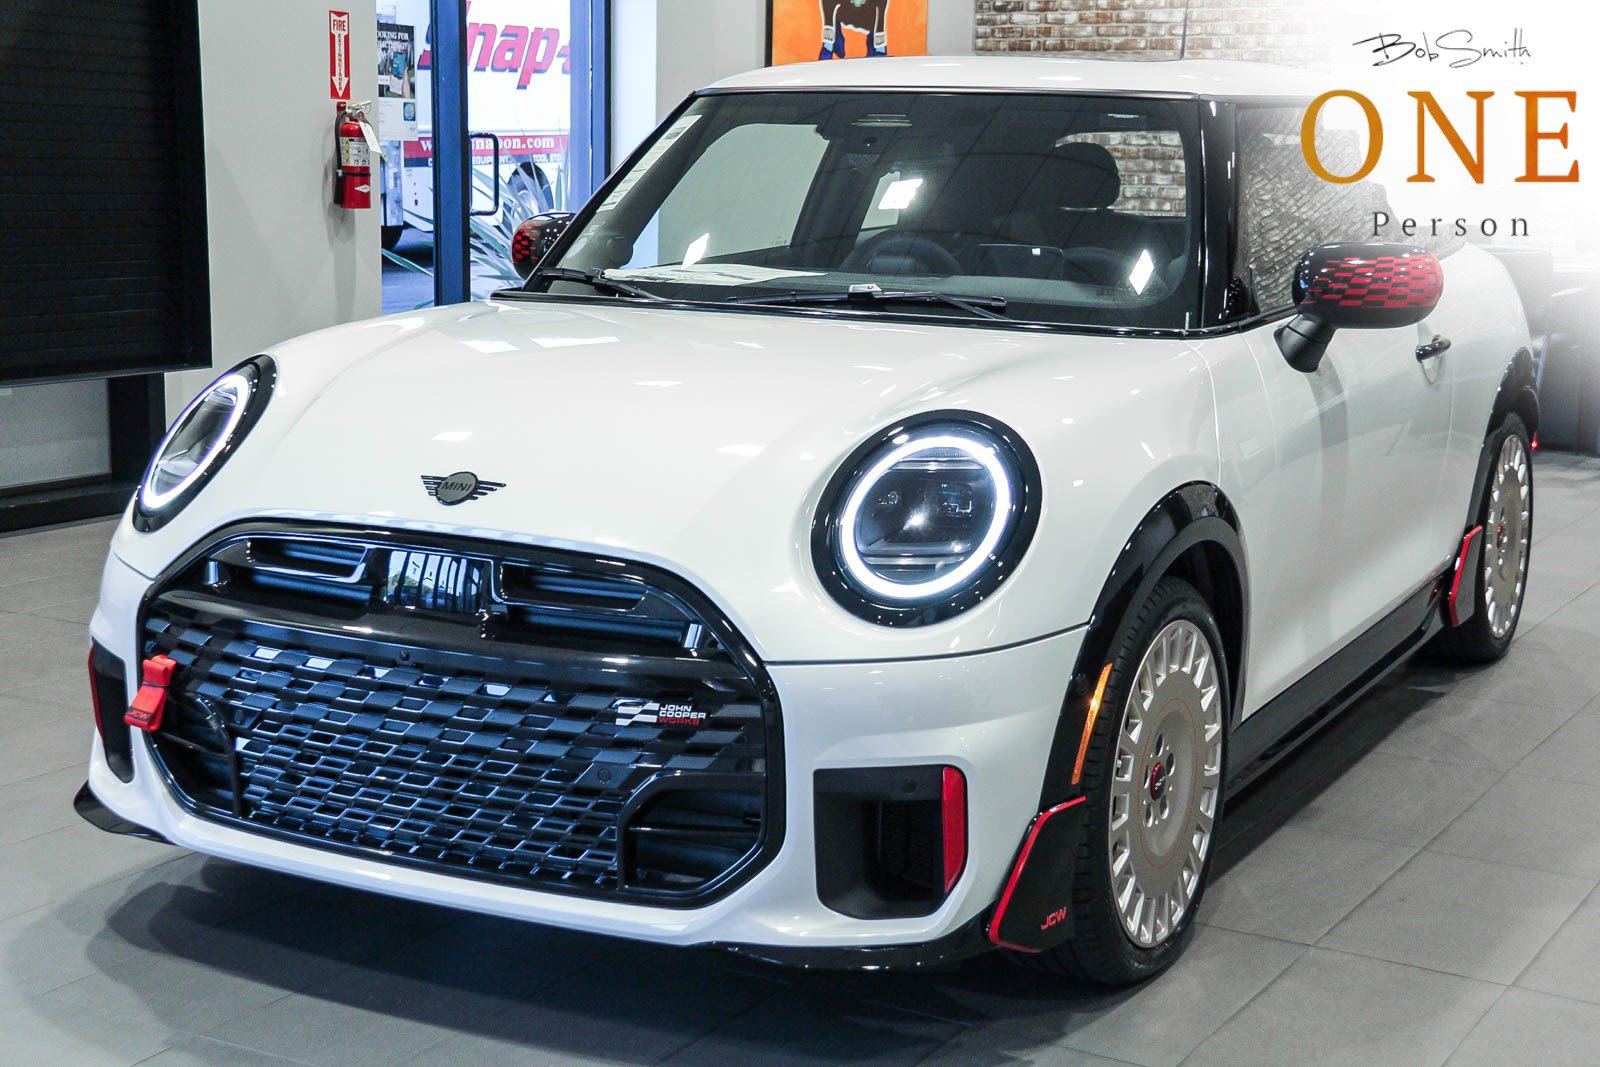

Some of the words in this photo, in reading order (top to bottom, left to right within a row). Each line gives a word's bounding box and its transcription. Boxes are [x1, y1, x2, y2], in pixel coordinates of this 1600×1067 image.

[333, 20, 346, 31] FIRE
[398, 33, 409, 41] FOR
[441, 481, 472, 492] MINI
[660, 704, 692, 712] JOHN
[659, 710, 706, 719] COOPER
[659, 717, 700, 725] WORKS
[1041, 906, 1066, 930] JCW
